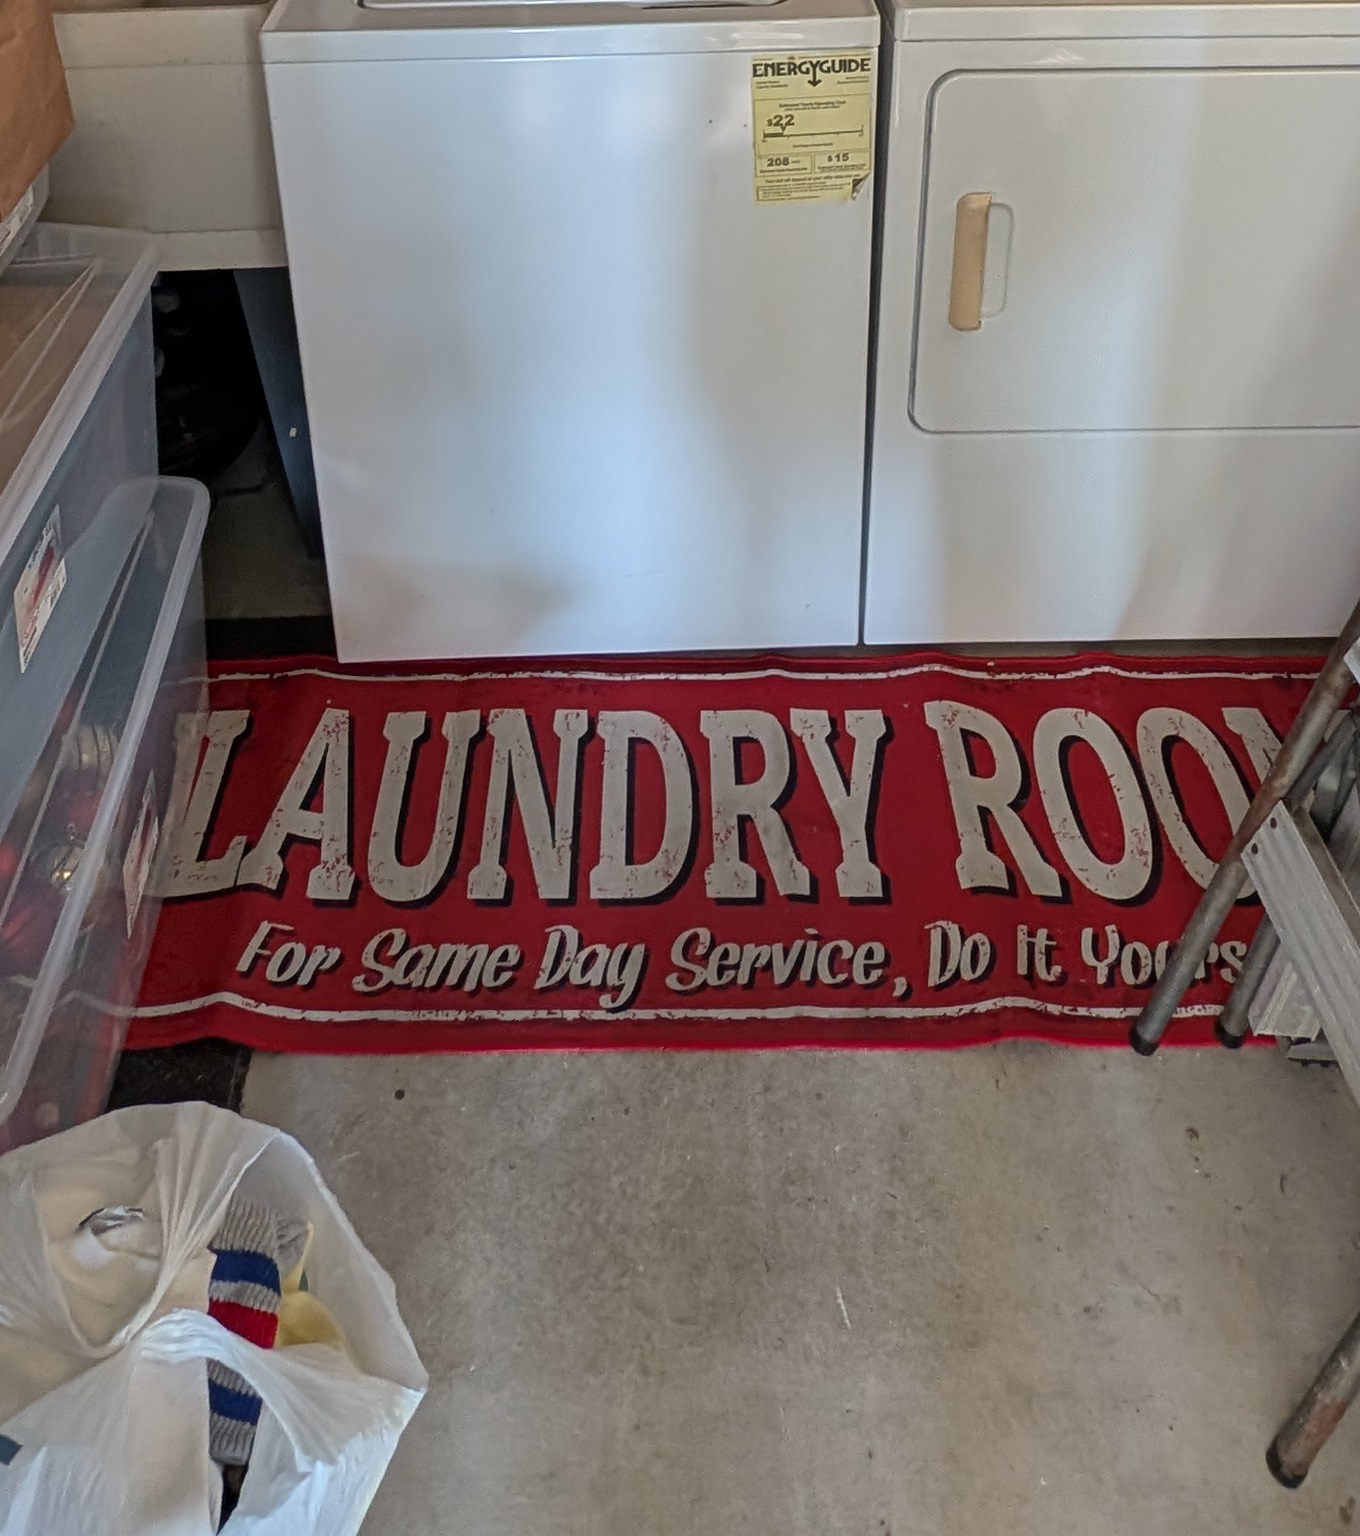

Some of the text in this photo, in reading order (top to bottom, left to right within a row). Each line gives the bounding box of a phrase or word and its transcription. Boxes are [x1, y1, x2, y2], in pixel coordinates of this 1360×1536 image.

[752, 57, 871, 82] ENERGYGUIDE
[767, 157, 790, 167] 208
[157, 700, 1300, 903] LAUNDRY ROO
[236, 920, 343, 986] For
[351, 926, 523, 993] Same
[535, 924, 646, 1008] Day
[665, 927, 907, 998] Service,
[924, 919, 992, 989] Do
